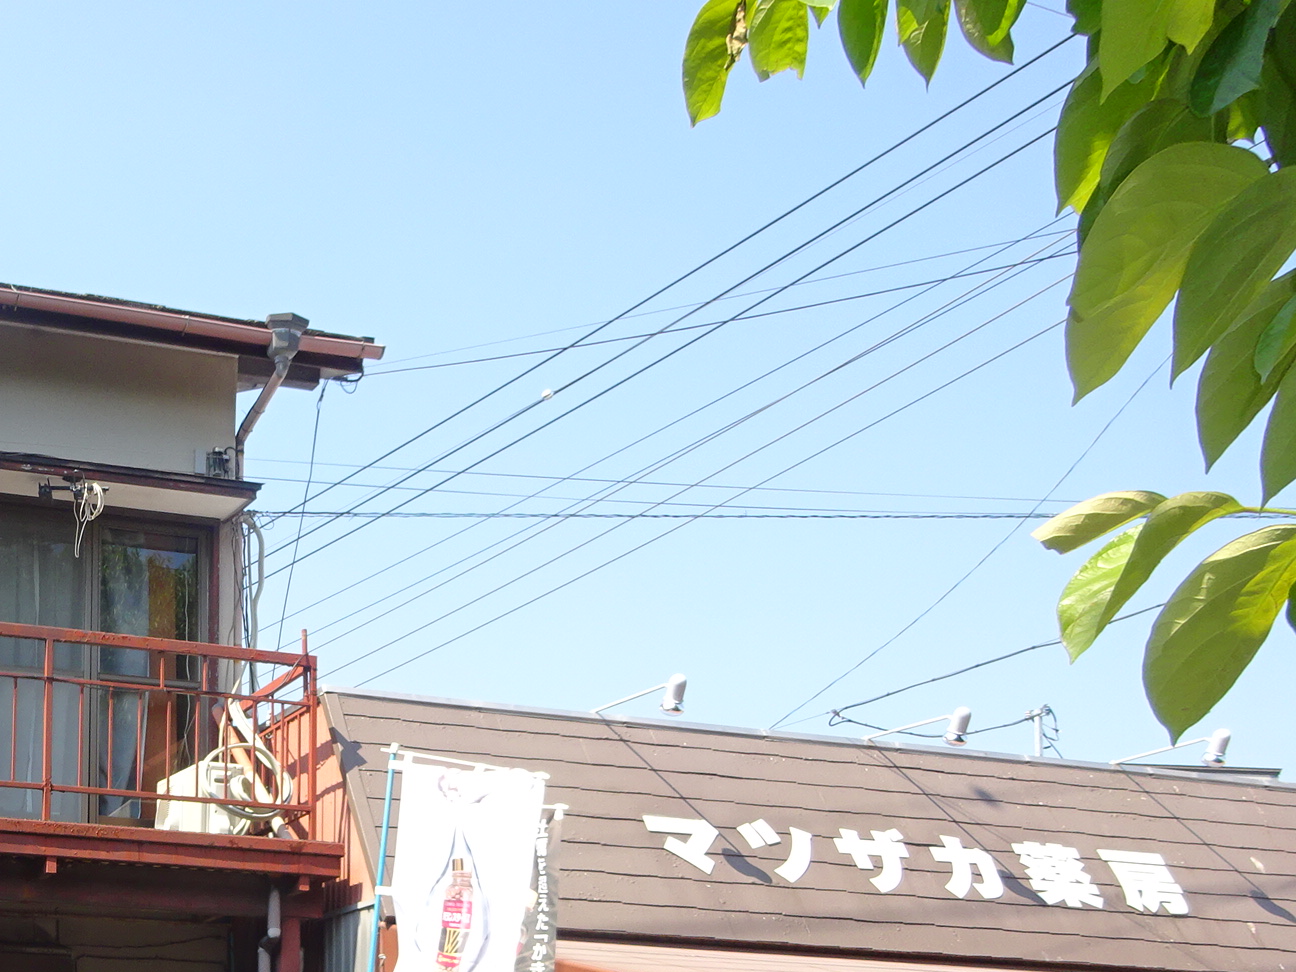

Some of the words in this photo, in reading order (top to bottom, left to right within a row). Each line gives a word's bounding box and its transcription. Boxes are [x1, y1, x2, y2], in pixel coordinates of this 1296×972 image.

[642, 814, 1189, 915] マツザカ薬房
